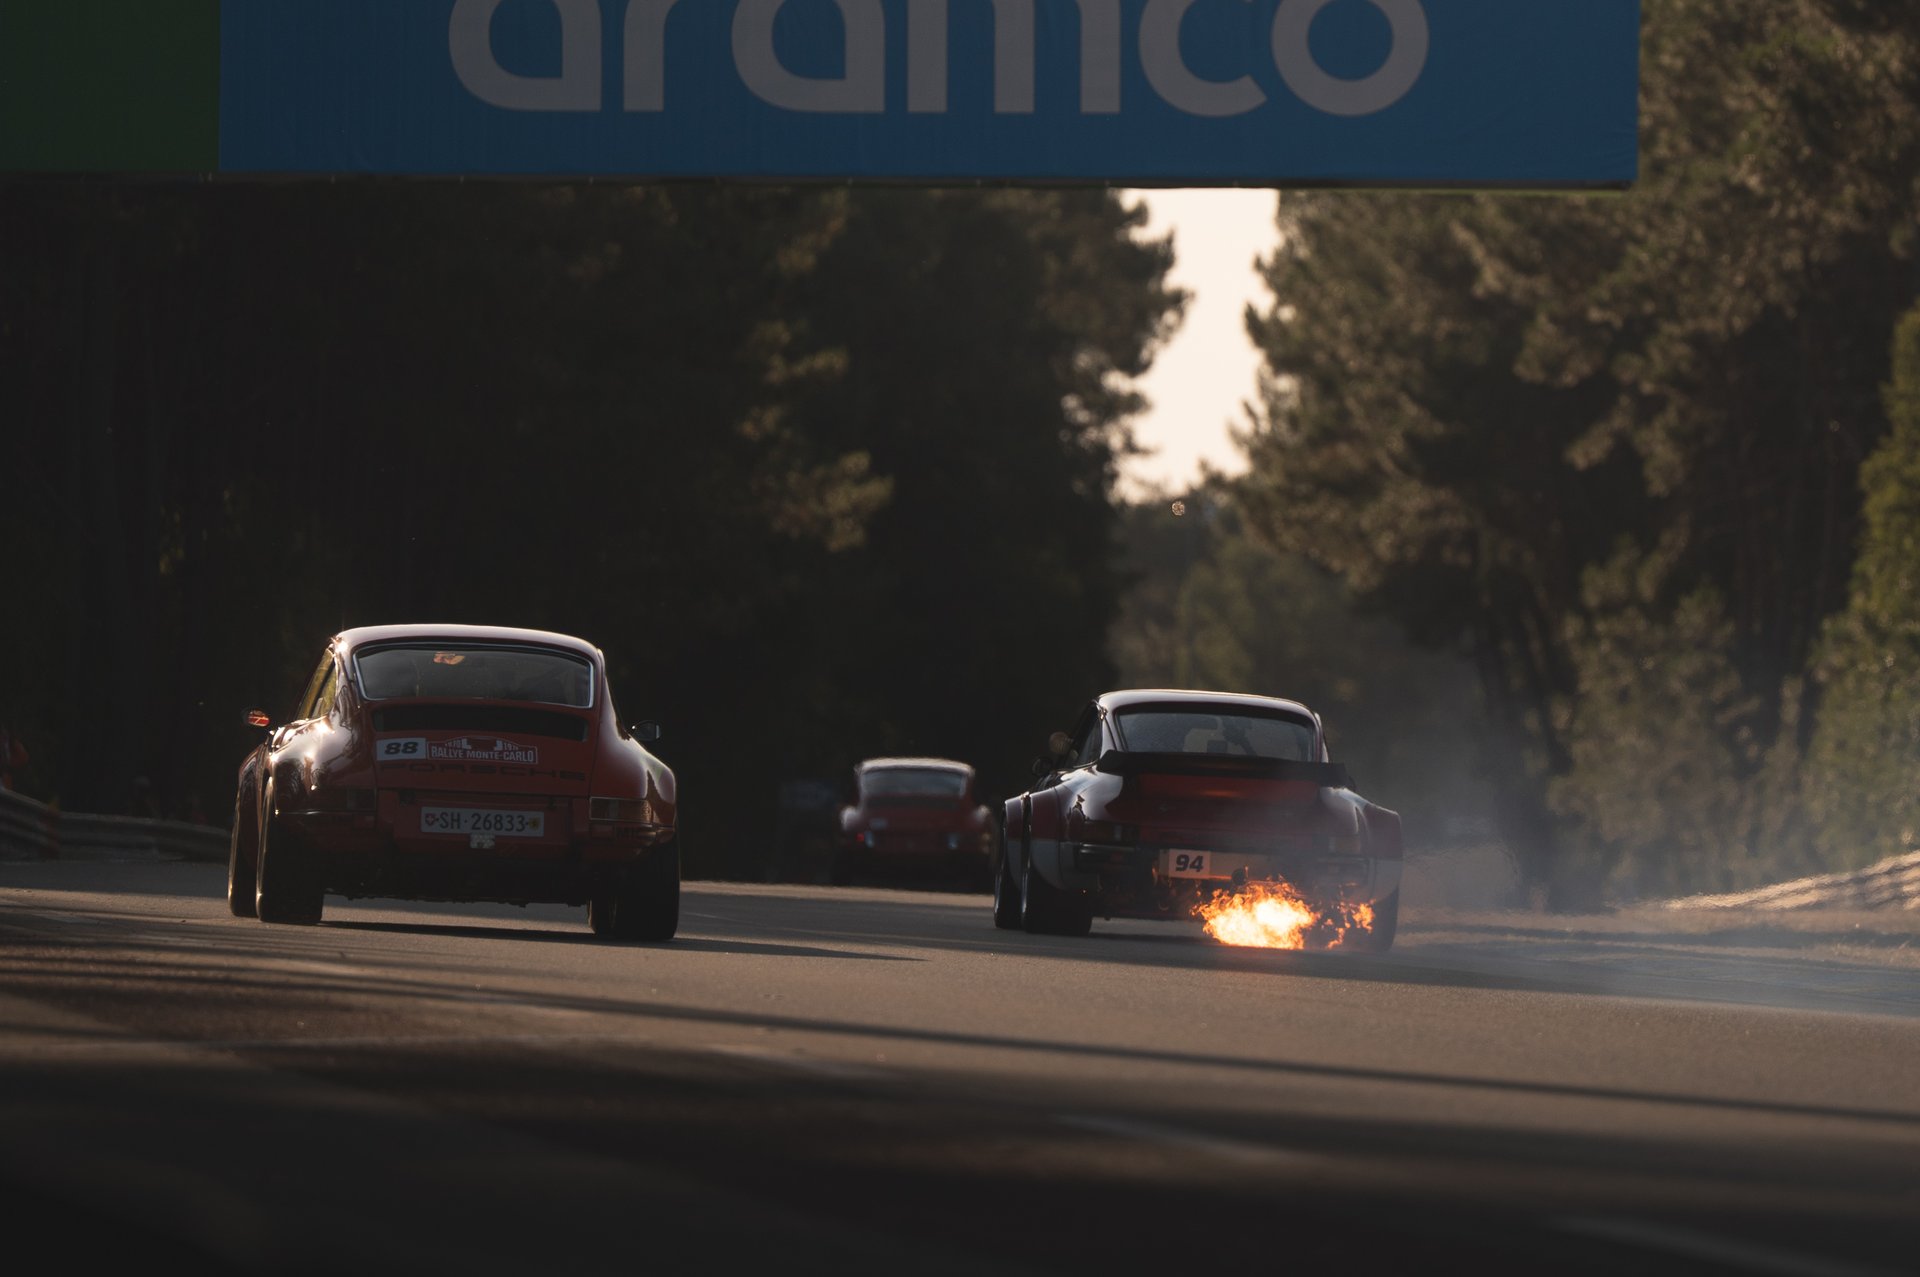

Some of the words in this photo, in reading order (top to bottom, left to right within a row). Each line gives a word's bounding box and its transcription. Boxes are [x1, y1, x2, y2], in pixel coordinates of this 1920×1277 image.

[449, 0, 1430, 118] aramco
[384, 741, 418, 755] 88
[431, 745, 463, 758] RALLYE
[1175, 854, 1204, 872] 94
